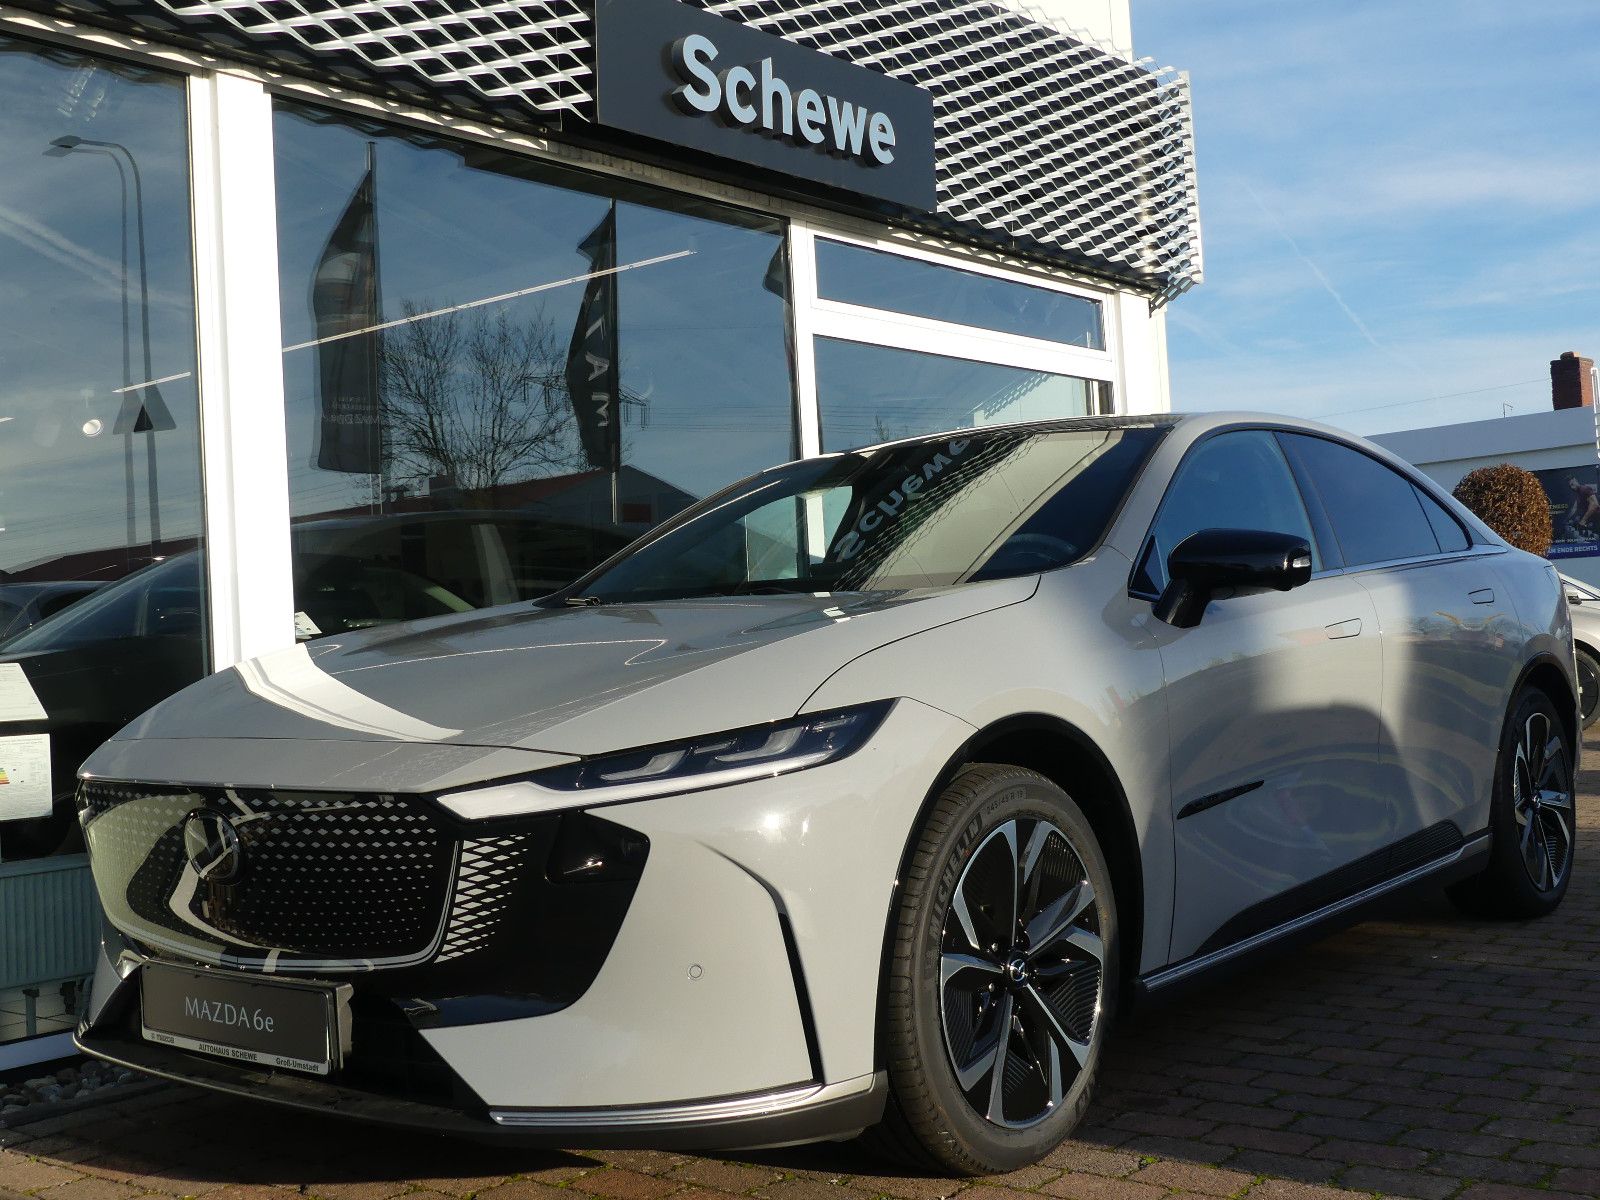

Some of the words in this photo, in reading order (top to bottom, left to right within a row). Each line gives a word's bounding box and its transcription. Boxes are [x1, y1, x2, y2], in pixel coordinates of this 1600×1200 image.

[674, 33, 896, 165] Schewe
[929, 811, 982, 941] MICHELIN
[184, 995, 251, 1029] MAZDA
[253, 1006, 274, 1033] 6e
[198, 1043, 230, 1056] AUTOHAUS
[231, 1049, 258, 1061] SCHEWE
[275, 1057, 319, 1072] Groß-Umstadt
